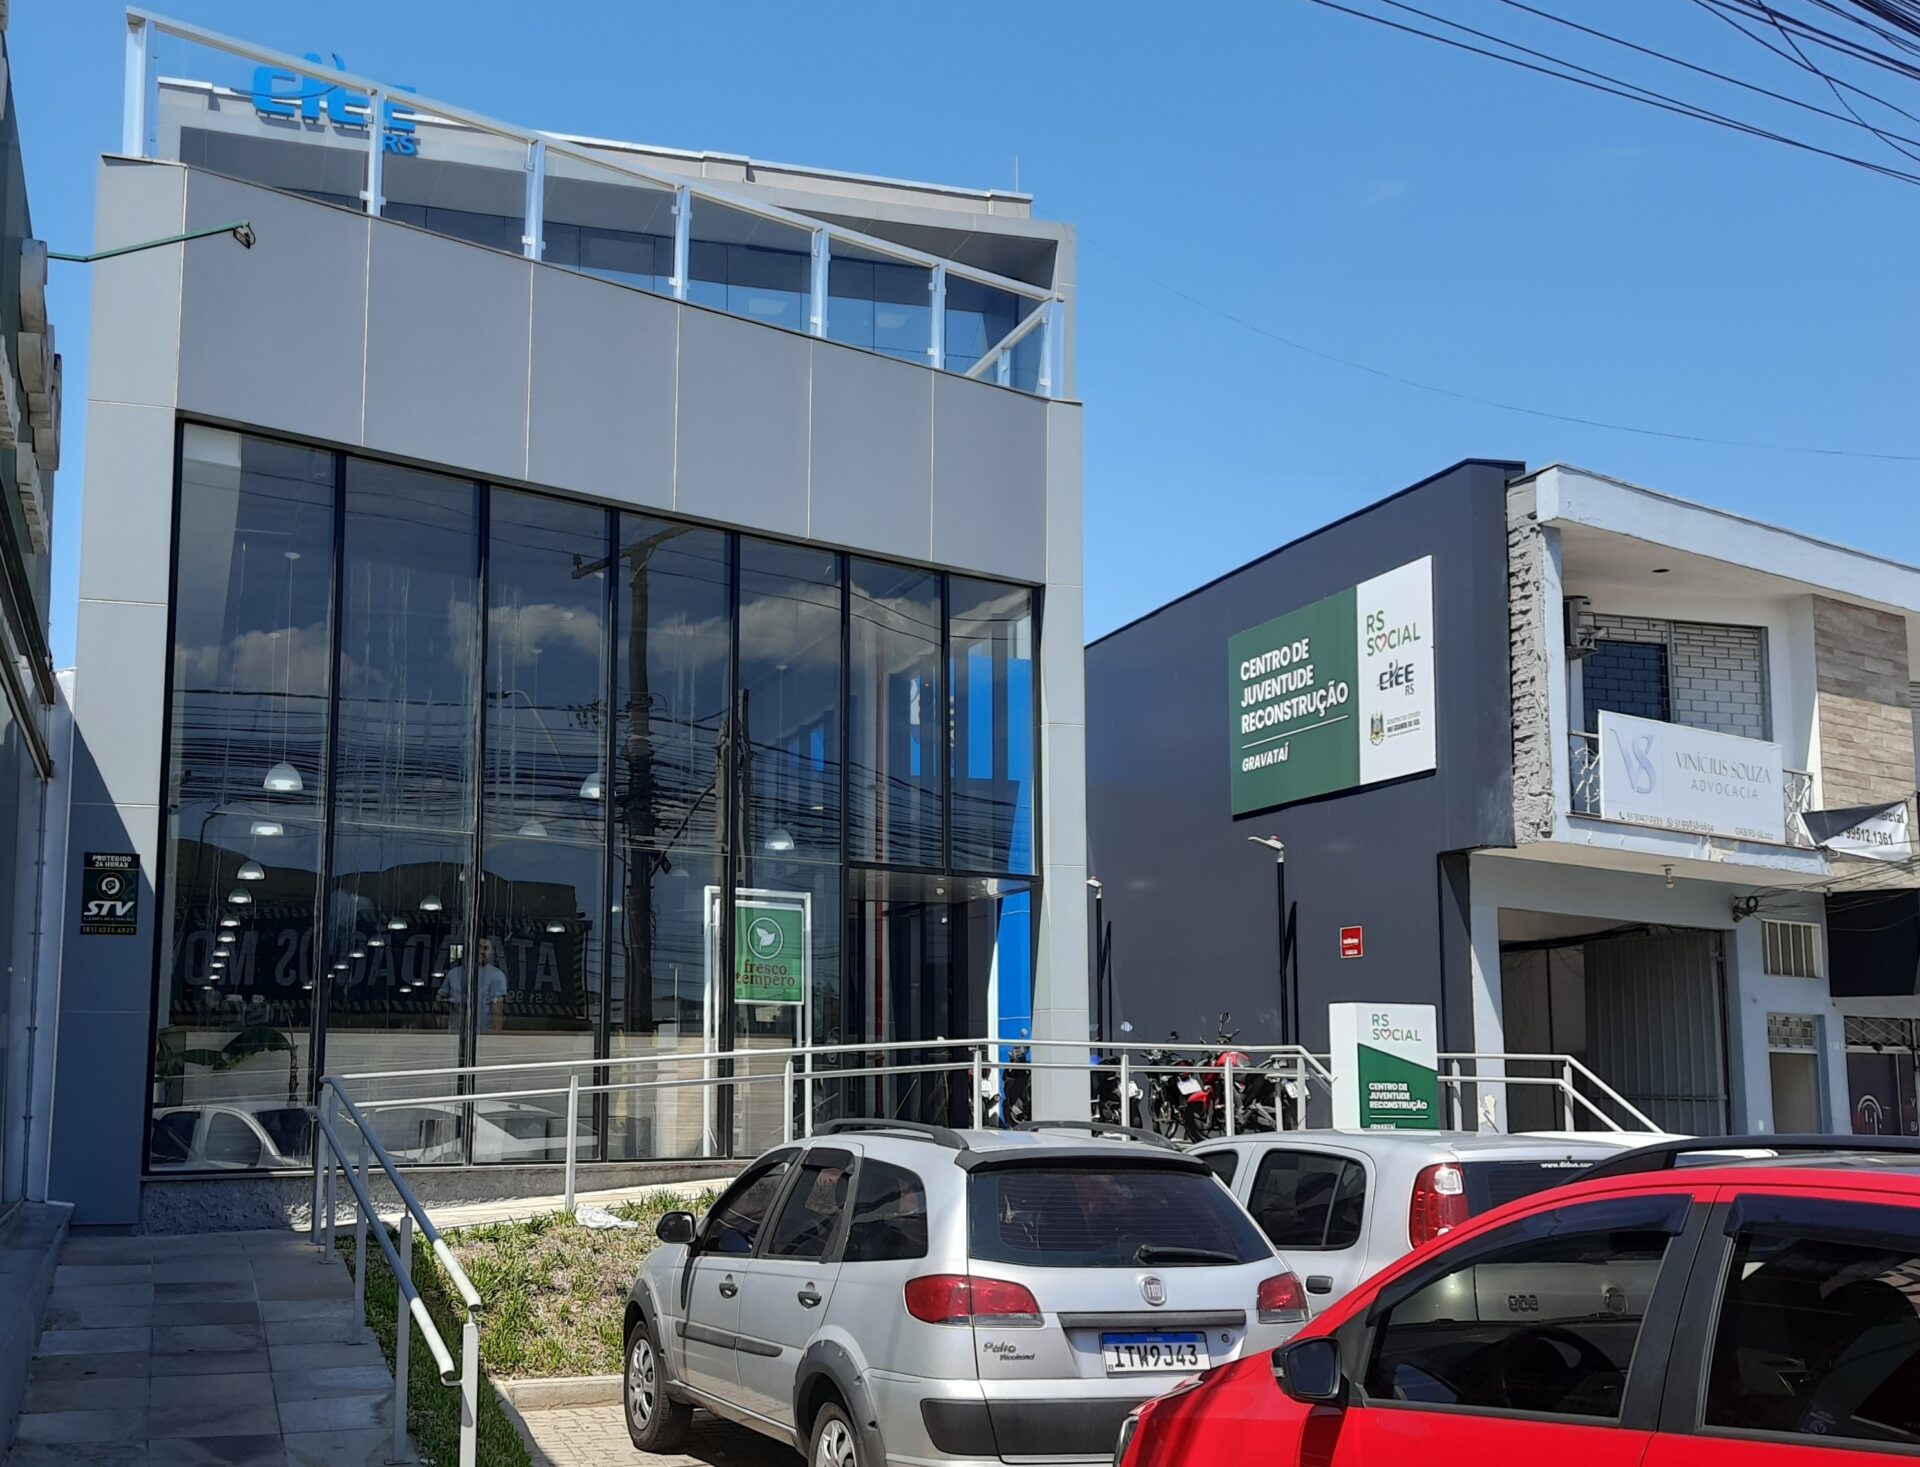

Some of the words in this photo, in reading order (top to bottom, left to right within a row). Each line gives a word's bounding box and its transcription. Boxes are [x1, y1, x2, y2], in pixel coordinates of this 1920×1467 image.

[383, 134, 417, 156] RS
[1366, 610, 1385, 635] RS
[1241, 646, 1291, 681] CENTRO
[1292, 638, 1310, 663] DE
[1241, 664, 1314, 707] JUVENTUDE
[1241, 680, 1349, 734] RECONSTRUÇÃO
[1242, 741, 1290, 772] GRAVATAÍ
[1675, 750, 1728, 777] VINÍCIUS
[1730, 762, 1771, 785] SOUZA
[1691, 778, 1759, 800] ADVOCACIA
[1846, 827, 1893, 845] 99512.1361
[83, 901, 135, 916] STV
[743, 959, 787, 975] fresco
[736, 971, 796, 988] tempero
[1371, 1013, 1389, 1027] RS
[1369, 1083, 1397, 1091] CENTRO
[1398, 1083, 1408, 1091] DE
[1369, 1092, 1411, 1100] JUVENTUDE
[1369, 1100, 1428, 1111] RECONSTRUÇÃO
[983, 1341, 1017, 1354] Palio
[1114, 1344, 1199, 1368] ITW9J43
